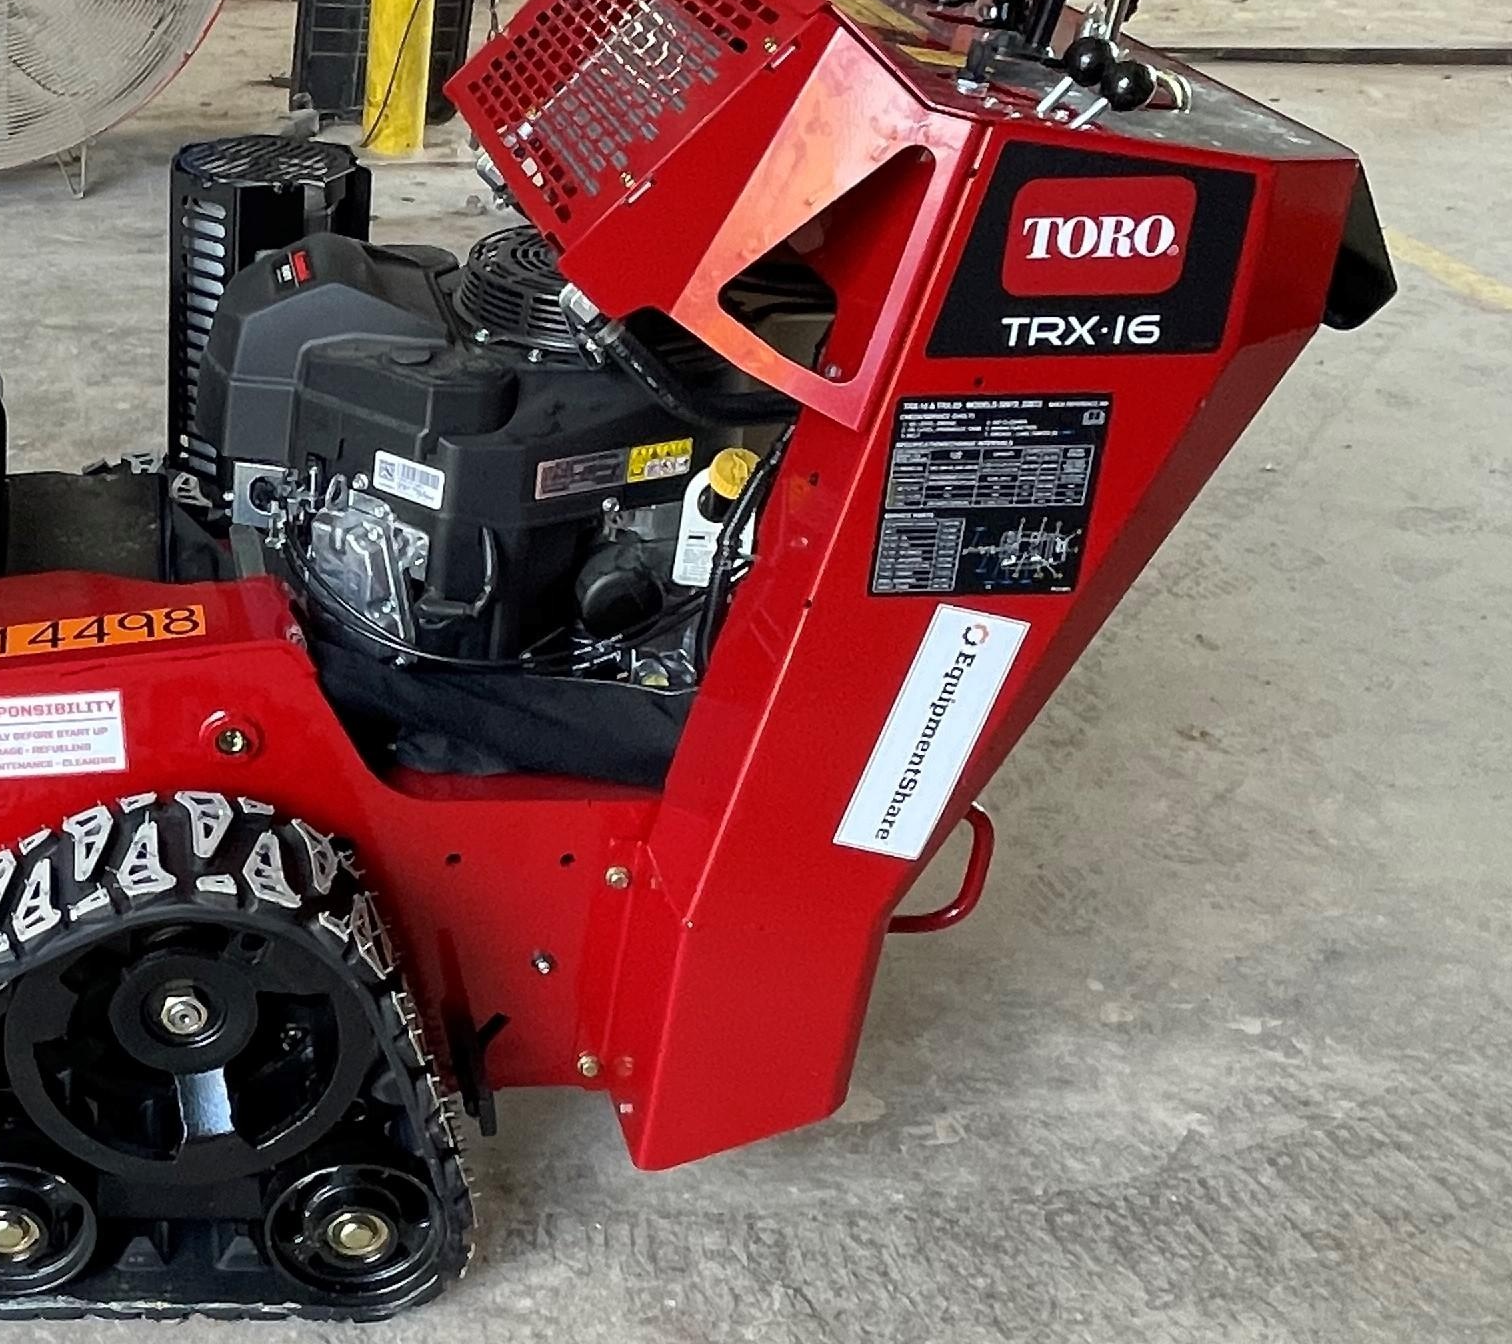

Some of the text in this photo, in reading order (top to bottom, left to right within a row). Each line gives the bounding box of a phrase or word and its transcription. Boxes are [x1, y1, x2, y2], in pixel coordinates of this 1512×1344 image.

[1022, 214, 1177, 259] TORO
[92, 727, 108, 736] UP
[875, 651, 977, 840] EquipmentShare
